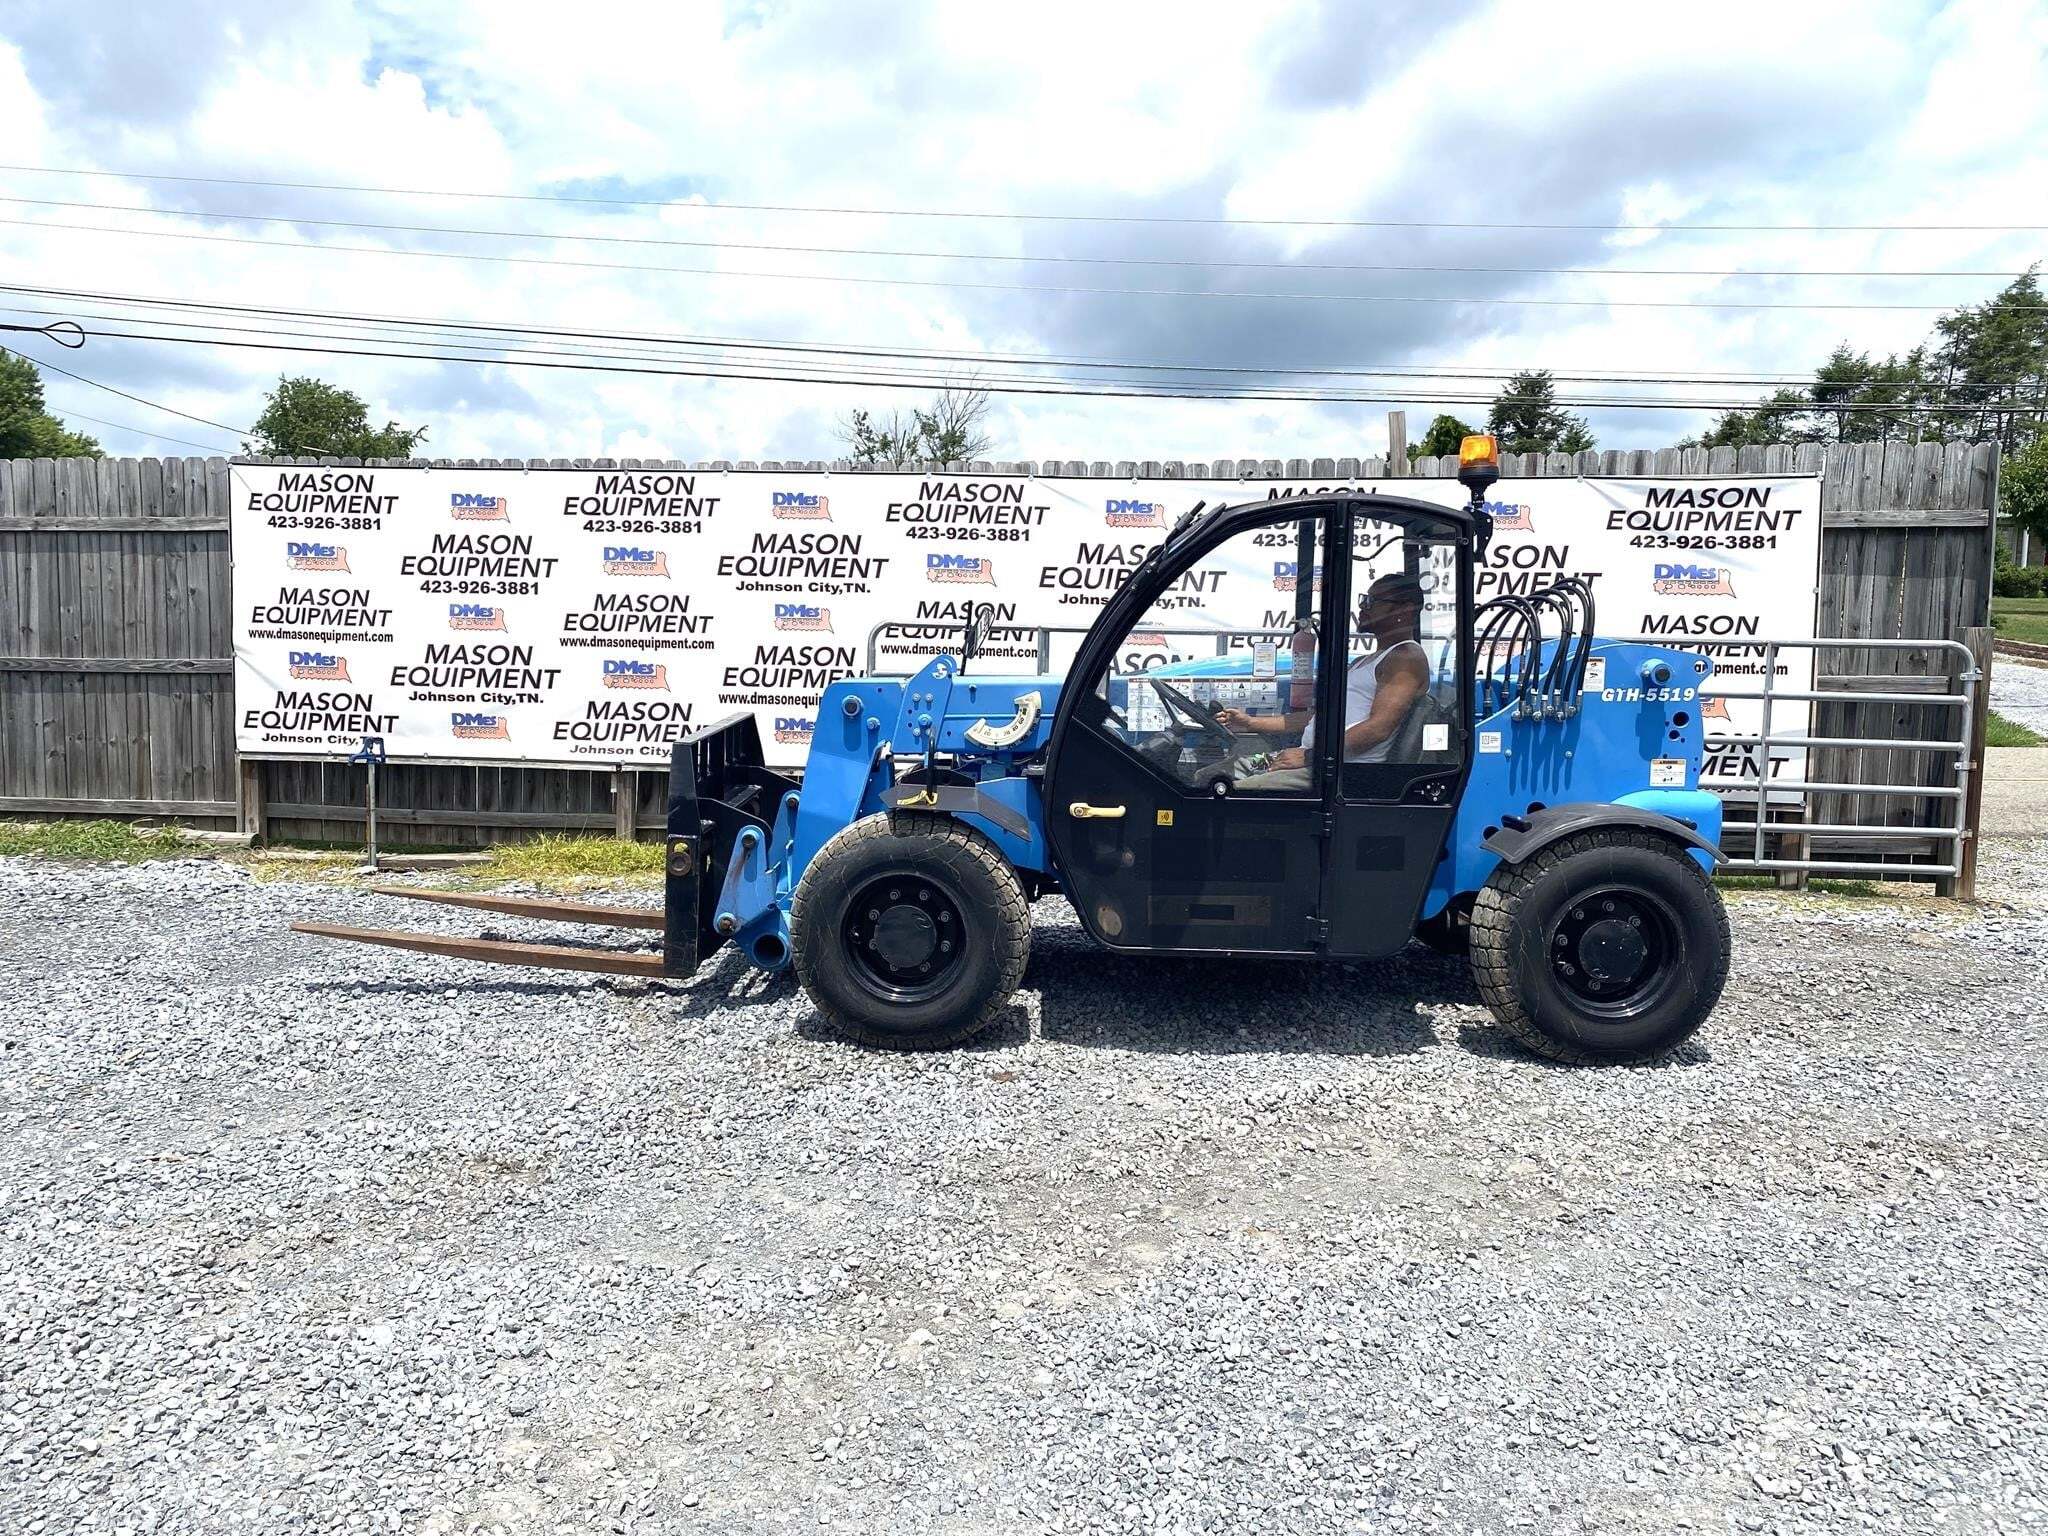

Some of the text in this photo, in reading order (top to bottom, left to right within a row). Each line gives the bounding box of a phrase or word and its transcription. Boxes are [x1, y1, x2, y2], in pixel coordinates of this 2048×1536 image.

[278, 473, 374, 493] MASON
[596, 476, 695, 495] MASON
[919, 482, 1024, 503] MASON
[248, 493, 399, 514] EQUIPMENT
[564, 497, 720, 516] EQUIPMENT
[1646, 488, 1771, 508] MASON
[268, 516, 380, 530] 423-926-3881
[886, 503, 1050, 525] EQUIPMENT
[1606, 510, 1802, 531] EQUIPMENT
[583, 520, 701, 533] 423-926-3881
[906, 527, 1029, 541] 423-926-3881
[432, 534, 532, 554] MASON
[752, 533, 861, 555] MASON
[1630, 535, 1776, 549] 423-926-3881
[401, 556, 558, 577] EQUIPMENT
[718, 556, 889, 578] EQUIPMENT
[279, 587, 369, 607] MASON
[420, 580, 538, 595] 423-926-3881
[736, 581, 870, 595] Johnson City,TN.
[594, 594, 689, 613] MASON
[252, 606, 392, 626] EQUIPMENT
[564, 614, 713, 633] EQUIPMENT
[1641, 615, 1759, 635] MASON
[249, 628, 393, 643] www.dmasonequipment.com
[560, 636, 714, 651] www.dmasonequipment.com
[425, 644, 533, 665] MASON
[755, 646, 856, 666] MASON
[391, 666, 561, 689] EQUIPMENT
[275, 691, 372, 712] MASON
[409, 691, 543, 705] Johnson City,TN.
[1601, 688, 1695, 701] GTH-5519
[587, 701, 692, 721] MASON
[244, 711, 399, 733] EQUIPMENT
[262, 733, 322, 743] Johnson
[571, 745, 633, 754] Johnson
